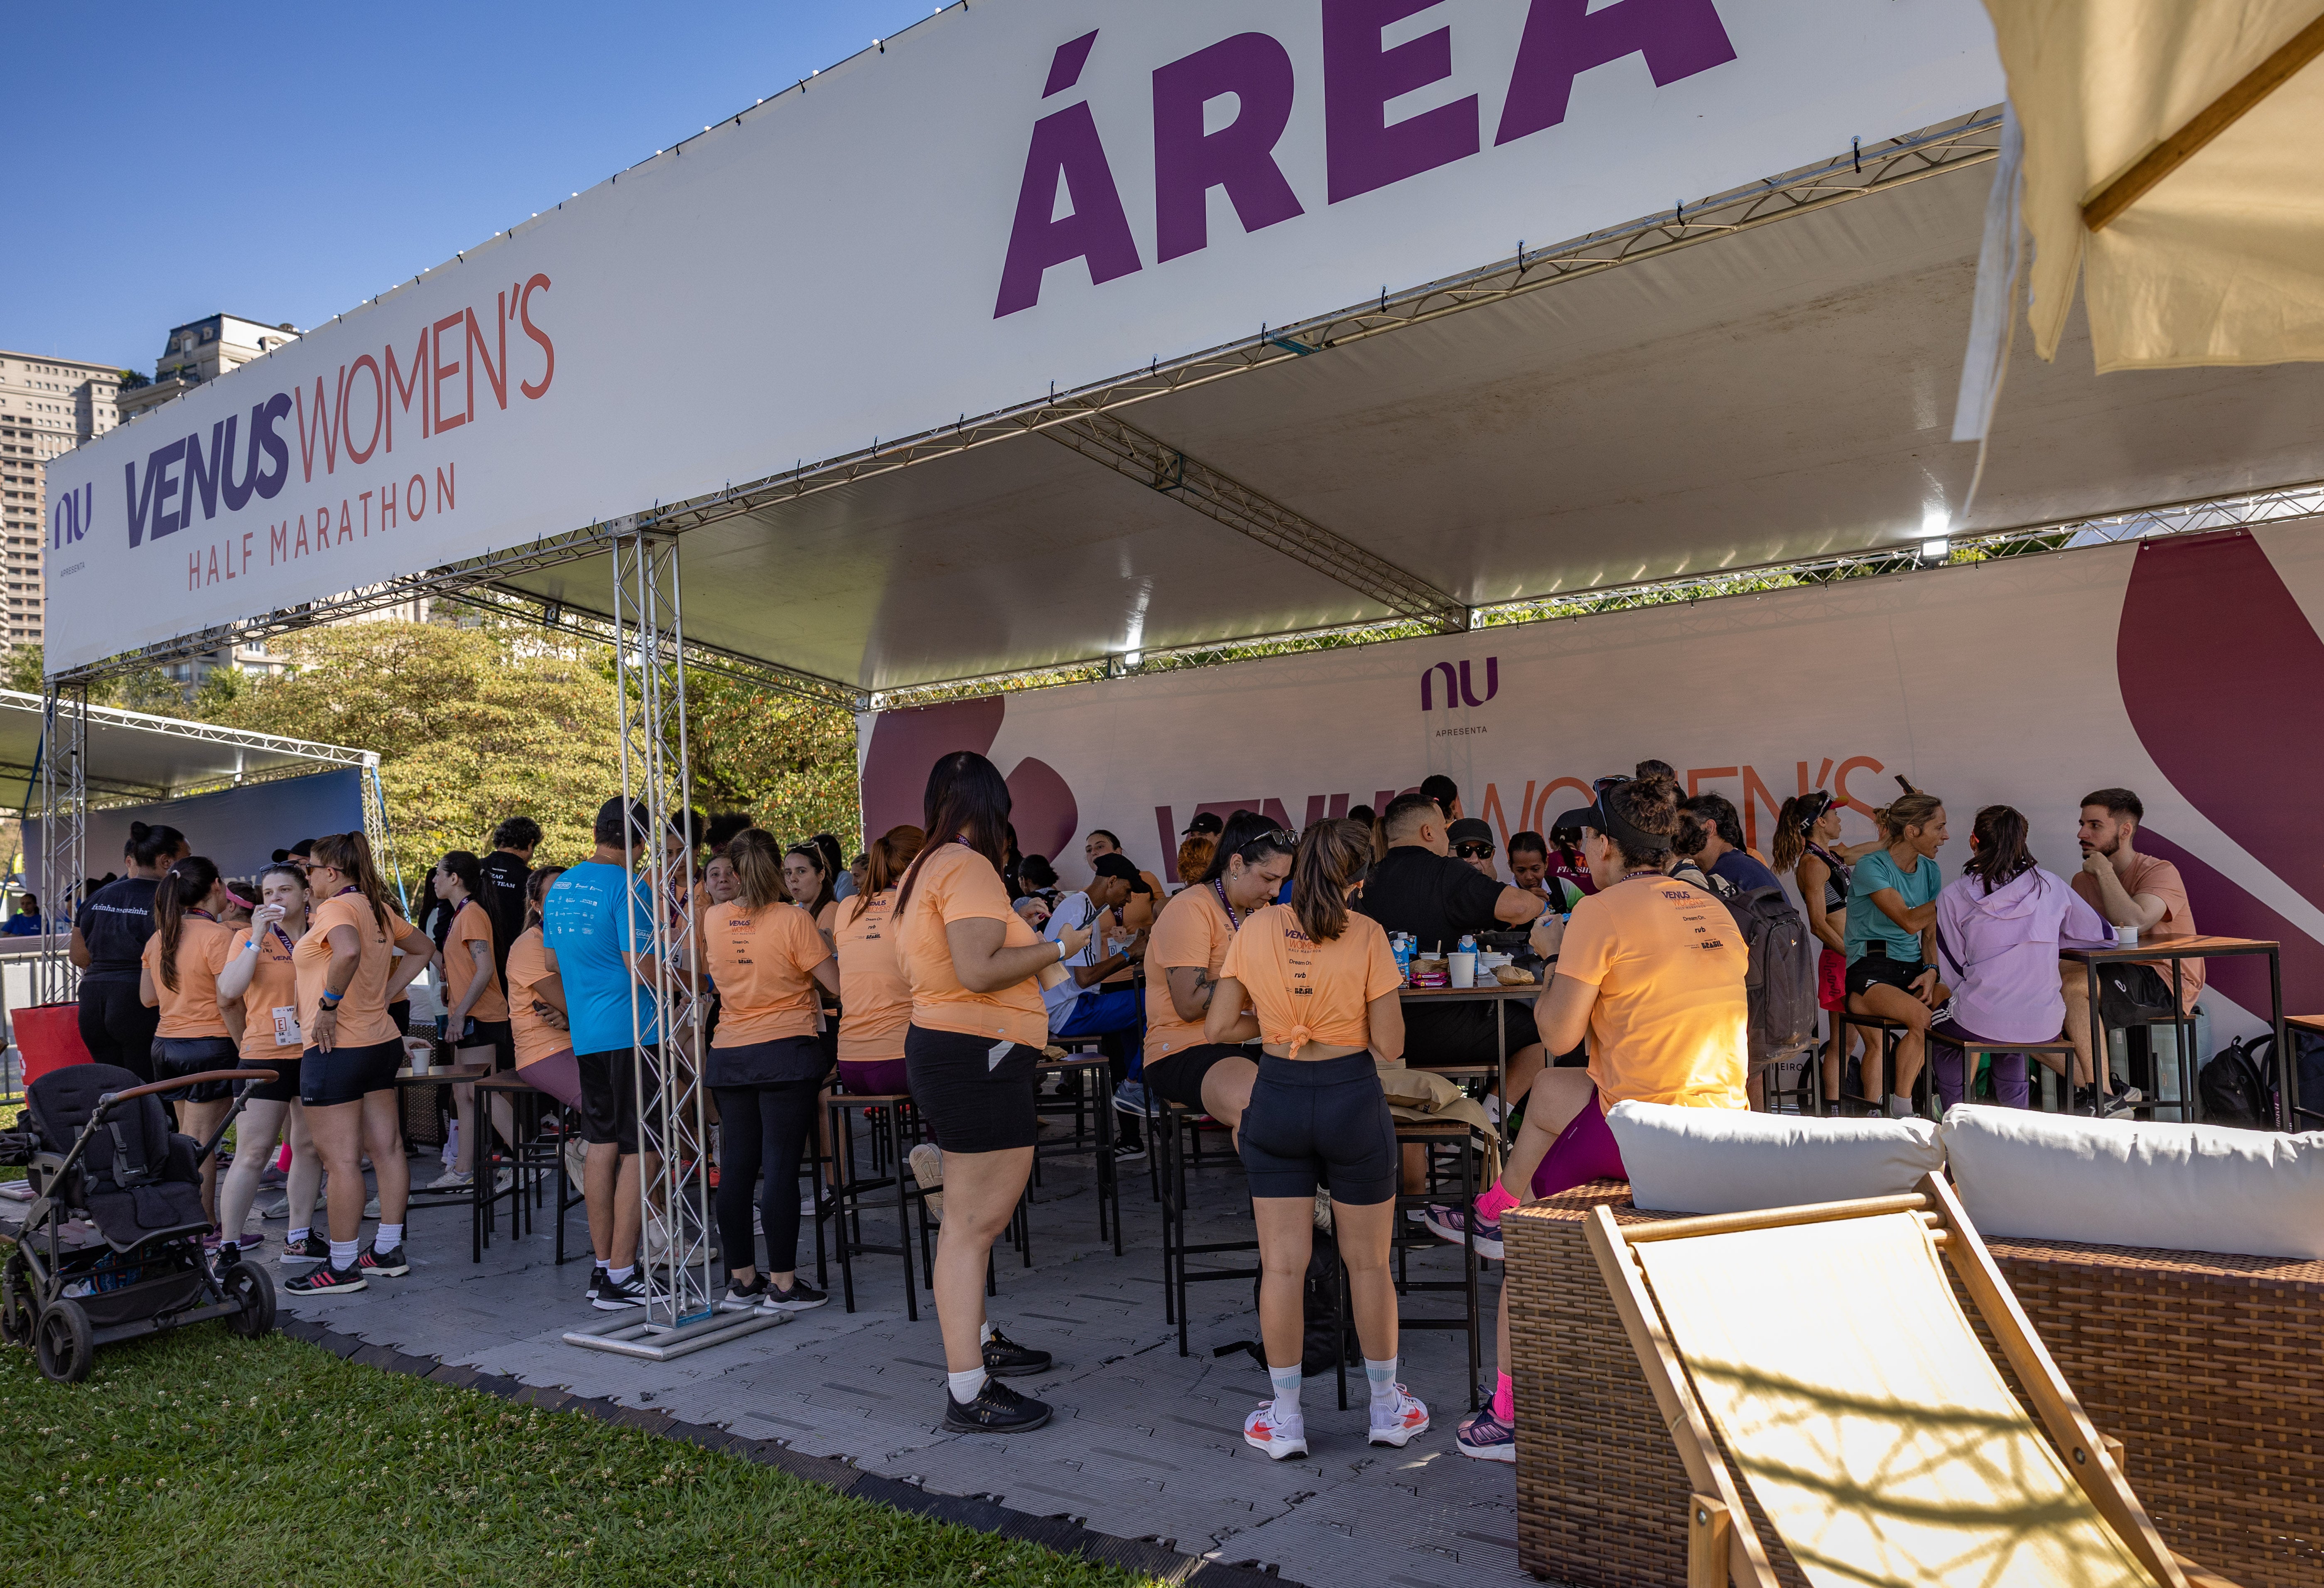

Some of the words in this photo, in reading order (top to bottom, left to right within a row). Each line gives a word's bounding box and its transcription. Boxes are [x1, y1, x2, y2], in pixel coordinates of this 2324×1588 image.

[993, 0, 1738, 320] ÁREA
[125, 393, 293, 548] VENUS
[188, 532, 254, 592] HALF
[270, 462, 456, 566] MARATHON
[60, 562, 86, 578] APRESENTA
[1436, 726, 1488, 737] APRESENTA
[1670, 898, 1703, 907] WOMEN'S
[1285, 929, 1310, 941] VENU
[1701, 940, 1724, 949] BRASIL
[278, 1020, 283, 1030] E
